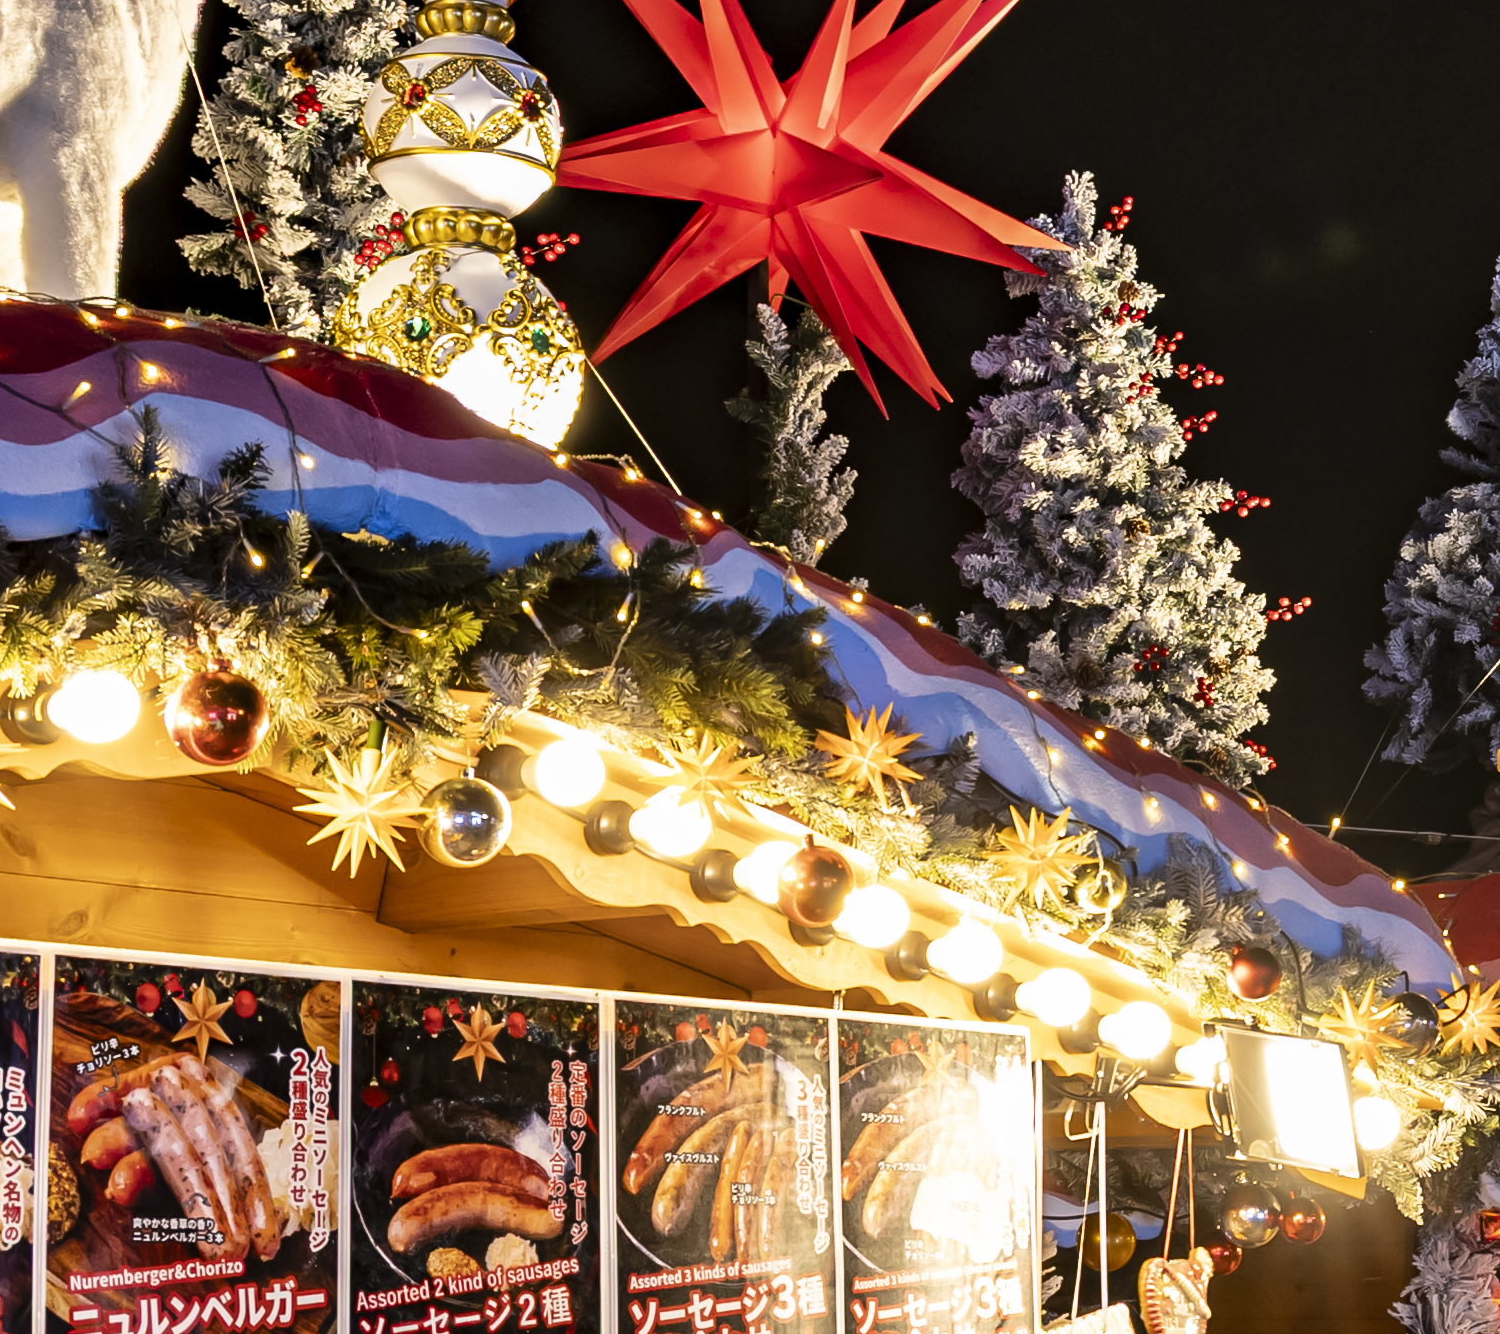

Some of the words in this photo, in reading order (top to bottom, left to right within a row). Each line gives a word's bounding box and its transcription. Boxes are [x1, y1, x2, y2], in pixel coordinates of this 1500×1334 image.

[91, 1038, 119, 1056] ピリ辛
[291, 1051, 308, 1203] 2種盛り合わせ
[658, 1105, 706, 1116] フランクフルト
[861, 1113, 905, 1124] フランクフルト
[3, 1070, 24, 1241] ミュンヘン名物の
[311, 1049, 329, 1249] 人気のミニソーセージ
[549, 1061, 566, 1220] 2種盛り合わせ
[570, 1062, 588, 1244] 定番のソーセージ
[664, 1153, 720, 1164] ヴァイスヴルスト
[798, 1080, 812, 1212] 3種盛り合わせ
[813, 1076, 829, 1252] 人気のミニソーセージ
[133, 1232, 224, 1244] ニュルンベルガー3本
[70, 1260, 244, 1292] Nuremberger&Chorizo
[357, 1281, 430, 1311] Assorted
[434, 1279, 444, 1297] 2
[448, 1273, 483, 1294] kind
[487, 1267, 503, 1286] of
[508, 1258, 579, 1284] sausages
[630, 1269, 682, 1291] Assorted
[684, 1270, 692, 1283] 3
[694, 1263, 725, 1282] kinds
[727, 1262, 740, 1276] of
[741, 1259, 791, 1275] sausages
[854, 1275, 890, 1290] Assorted
[891, 1276, 897, 1286] 3
[898, 1272, 920, 1284] kinds
[921, 1271, 930, 1281] of
[853, 1277, 1024, 1334] ソーセージ3種
